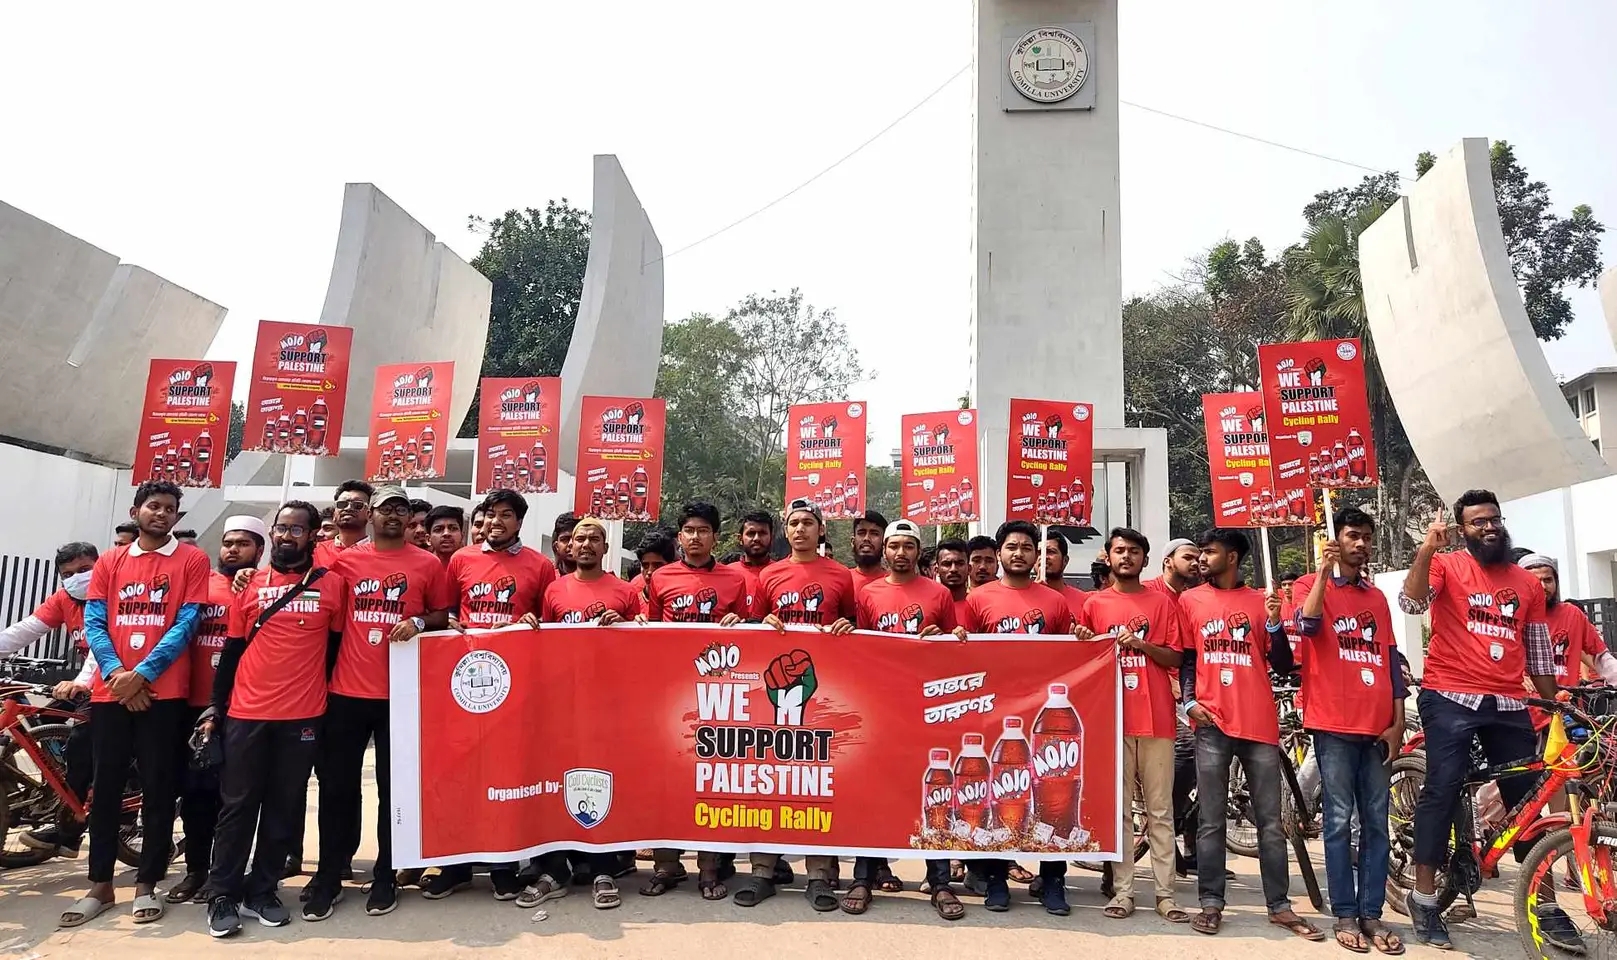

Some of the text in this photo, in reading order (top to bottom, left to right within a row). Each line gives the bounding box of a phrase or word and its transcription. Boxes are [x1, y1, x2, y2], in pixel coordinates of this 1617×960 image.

[1014, 69, 1084, 98] COMILLA UNIVERSITY
[280, 335, 304, 350] MOJO
[280, 350, 326, 364] SUPPORT
[278, 361, 324, 372] PALESTINE
[1276, 358, 1294, 371] MOJO
[168, 370, 192, 384] MOJO
[394, 374, 414, 388] MOJO
[1278, 372, 1300, 388] WE
[169, 386, 212, 396] SUPPORT
[394, 387, 432, 398] SUPPORT
[500, 388, 520, 402] MOJO
[1280, 386, 1334, 400] SUPPORT
[167, 396, 210, 406] PALESTINE
[392, 396, 432, 406] PALESTINE
[502, 402, 540, 412] SUPPORT
[1282, 399, 1338, 414] PALESTINE
[500, 411, 540, 420] PALESTINE
[602, 409, 624, 422] MOJO
[1283, 414, 1339, 426] Cycling Rally
[602, 424, 644, 434] SUPPORT
[800, 426, 817, 438] WE
[1022, 424, 1040, 436] WE
[1220, 419, 1243, 432] WE
[602, 433, 644, 443] PALESTINE
[800, 438, 842, 450] SUPPORT
[912, 434, 930, 446] WE
[1022, 438, 1067, 450] SUPPORT
[1224, 432, 1268, 445] SUPPOR
[800, 448, 842, 460] PALESTINE
[914, 445, 954, 456] SUPPORT
[1021, 448, 1068, 460] PALESTINE
[914, 454, 956, 466] PALESTINE
[1020, 460, 1068, 472] Cycling Rally
[1226, 459, 1256, 468] Cycling
[118, 583, 146, 601] MOJO
[354, 579, 380, 596] MOJO
[468, 582, 492, 599] MOJO
[354, 598, 406, 612] SUPPORT
[670, 594, 694, 612] MOJO
[776, 592, 800, 609] MOJO
[1468, 594, 1493, 606] MOJO
[118, 601, 169, 615] SUPPORT
[116, 614, 165, 627] PALESTINE
[561, 610, 582, 624] OJO
[778, 610, 824, 623] SUPPORT
[878, 612, 899, 630] MOJO
[996, 617, 1020, 632] MOJO
[1200, 618, 1225, 638] MOJO
[1332, 617, 1358, 634] MOJO
[1204, 638, 1252, 652] SUPPORT
[694, 645, 741, 676] MOJO
[1204, 652, 1252, 666] PALESTINE
[730, 672, 760, 680] Presents
[923, 672, 987, 698] অন্তরে
[454, 686, 509, 711] COMILLA UNIVERSITY
[696, 682, 750, 722] WE
[924, 693, 996, 724] তারুণ্য
[696, 726, 834, 761] SUPPORT
[1032, 740, 1079, 778] MOJO
[696, 762, 834, 797] PALESTINE
[992, 770, 1030, 799] MOJO
[488, 781, 542, 802] Organised
[926, 788, 952, 808] MOJO
[956, 780, 987, 805] MOJO
[694, 802, 832, 833] Cycling Rally
